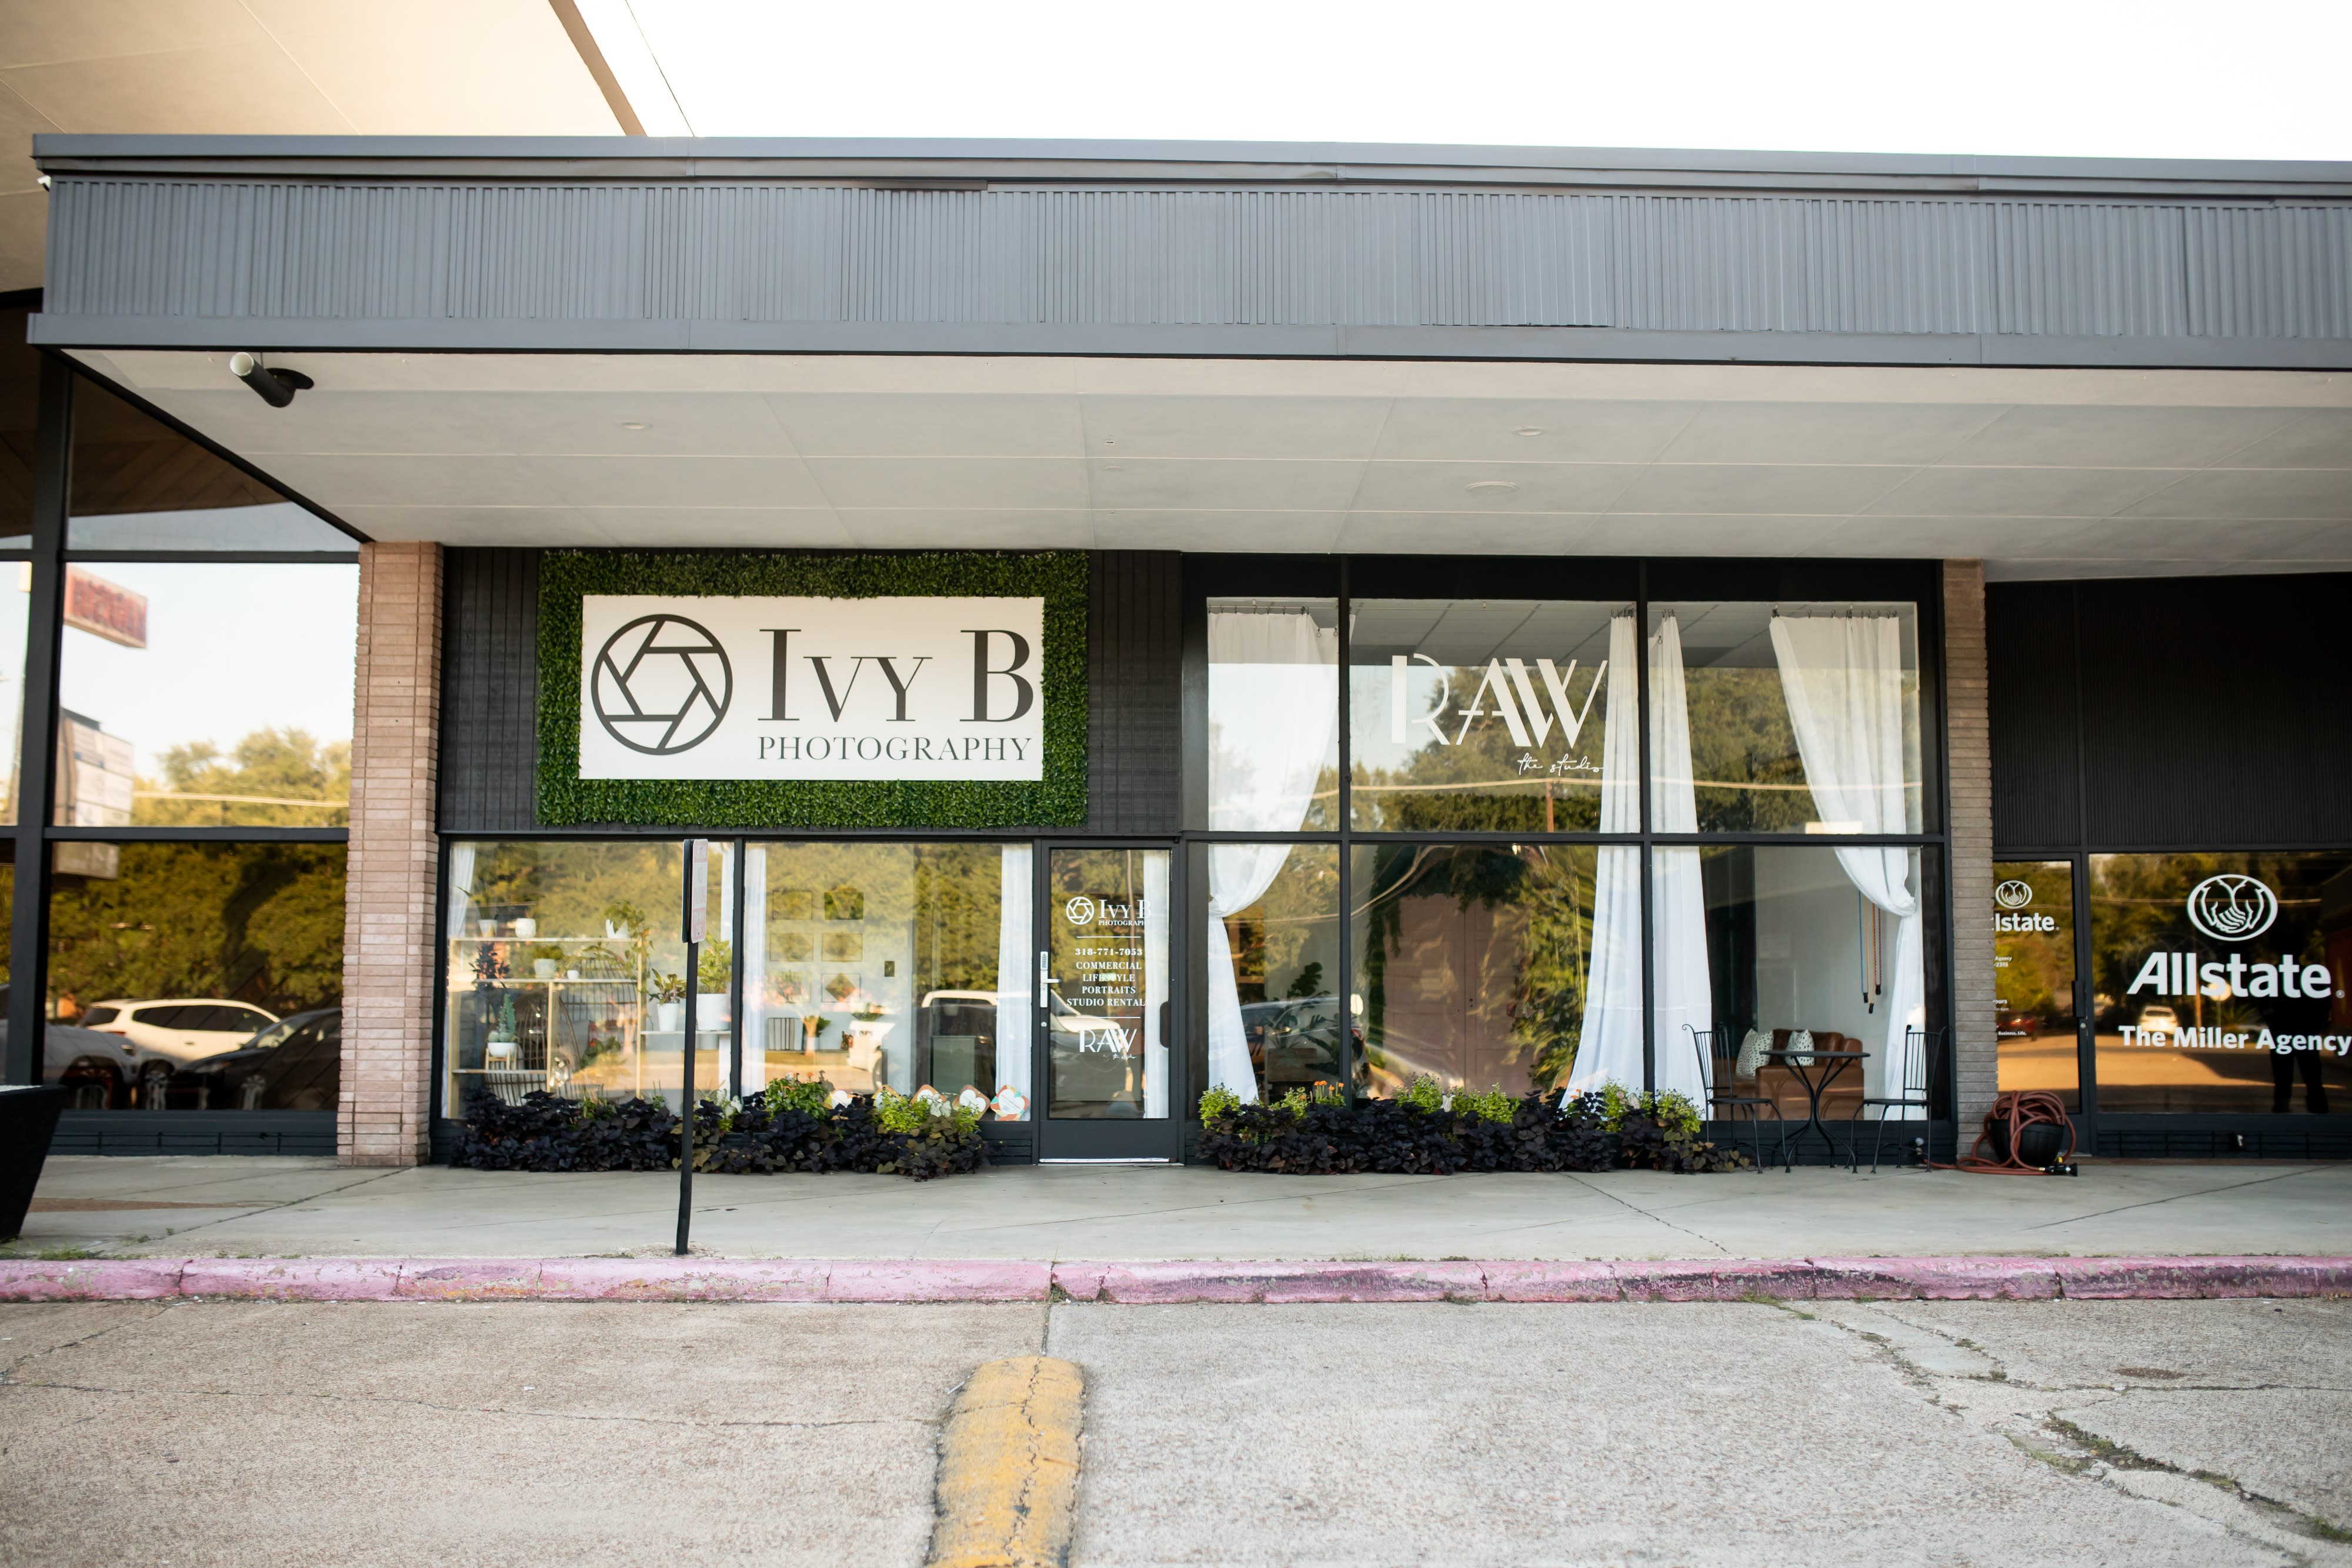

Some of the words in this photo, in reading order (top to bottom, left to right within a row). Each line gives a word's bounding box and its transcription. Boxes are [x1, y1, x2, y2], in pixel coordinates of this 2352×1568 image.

[959, 629, 1035, 722] B
[1391, 653, 1608, 749] RAW
[758, 736, 1033, 762] PHOTOGRAPHY
[1517, 752, 1543, 775] the
[1550, 753, 1605, 776] studio
[1136, 899, 1152, 919] B
[1991, 912, 2055, 932] lstate
[1076, 962, 1142, 970] COMMERCIAL
[2127, 952, 2331, 999] Allstate
[1067, 998, 1105, 1006] STUDIO
[1082, 986, 1136, 994] PORTRAITS
[1079, 1029, 1137, 1053] RAW
[2118, 1025, 2166, 1047] The
[2173, 1026, 2249, 1049] Miller
[2256, 1028, 2352, 1056] Agency
